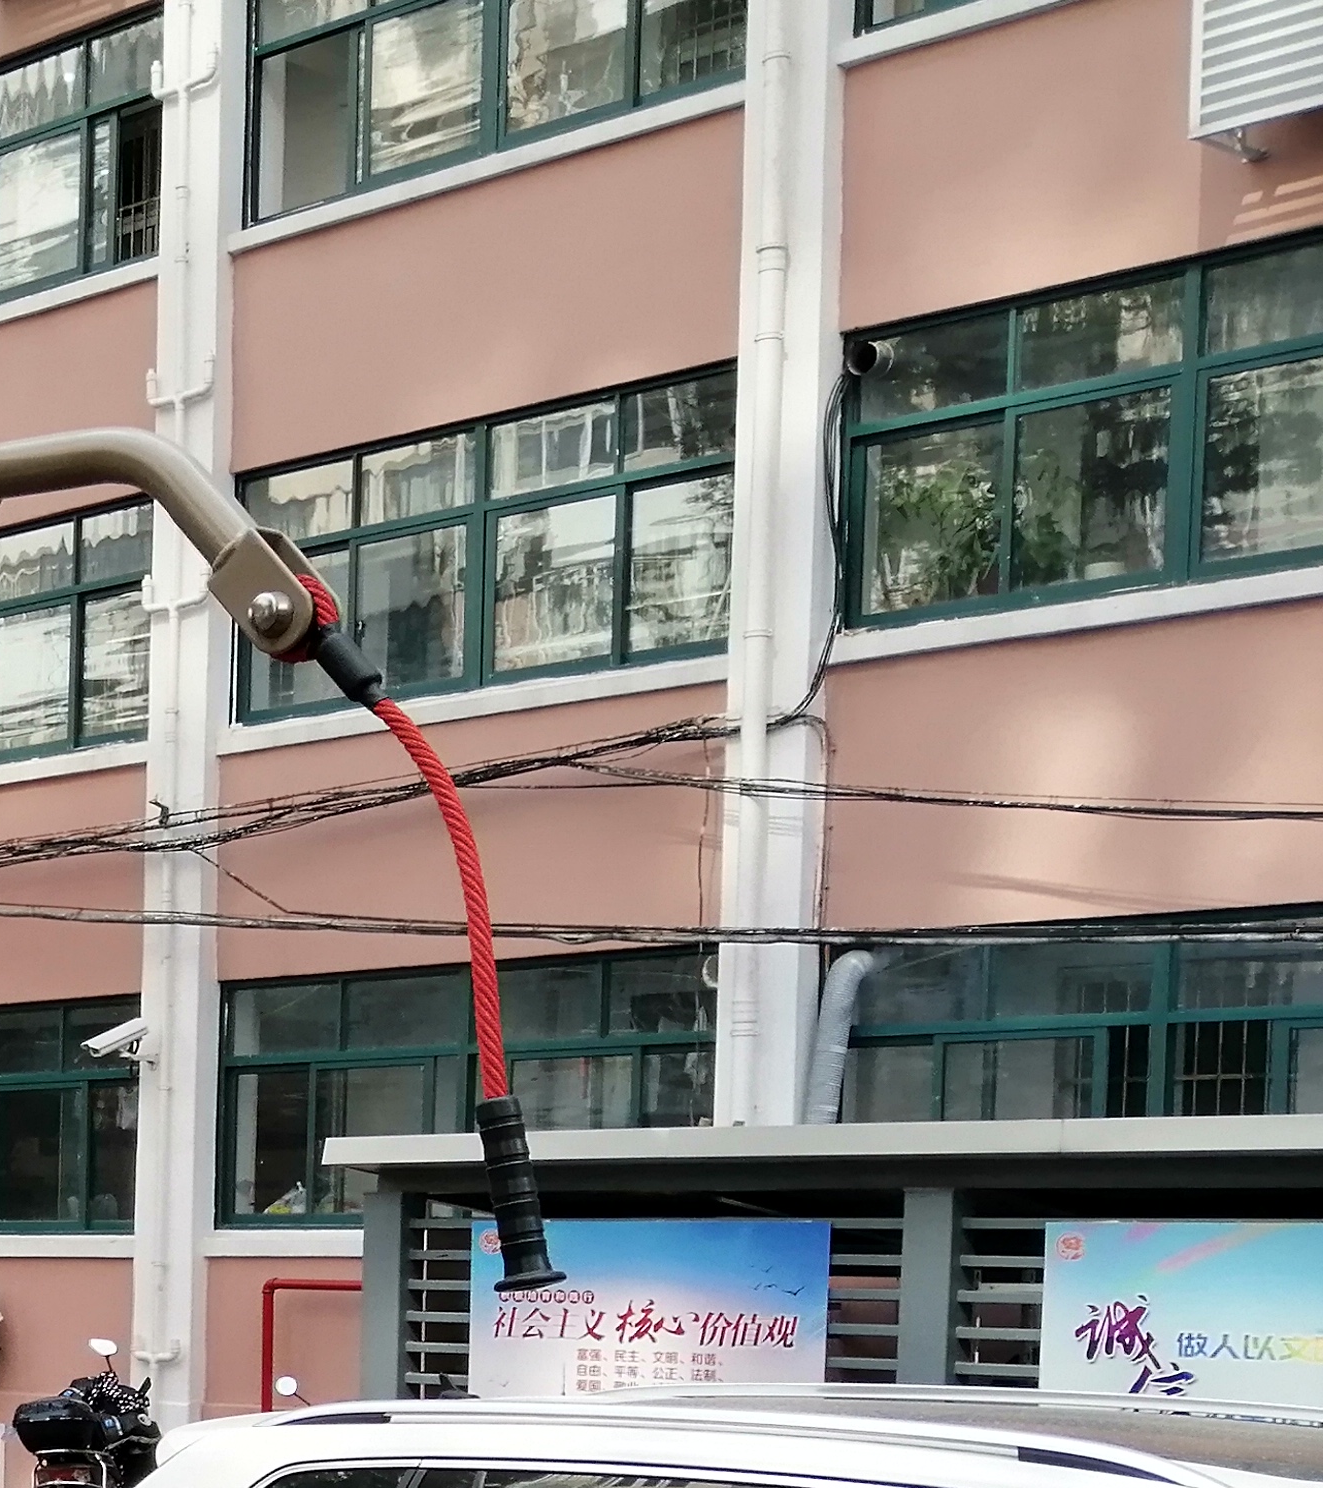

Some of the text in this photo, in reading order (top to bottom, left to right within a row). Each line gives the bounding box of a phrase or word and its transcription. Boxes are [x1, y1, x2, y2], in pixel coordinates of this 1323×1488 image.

[493, 1299, 800, 1350] 社会主义核心价值观
[1176, 1332, 1323, 1361] 做人以文
